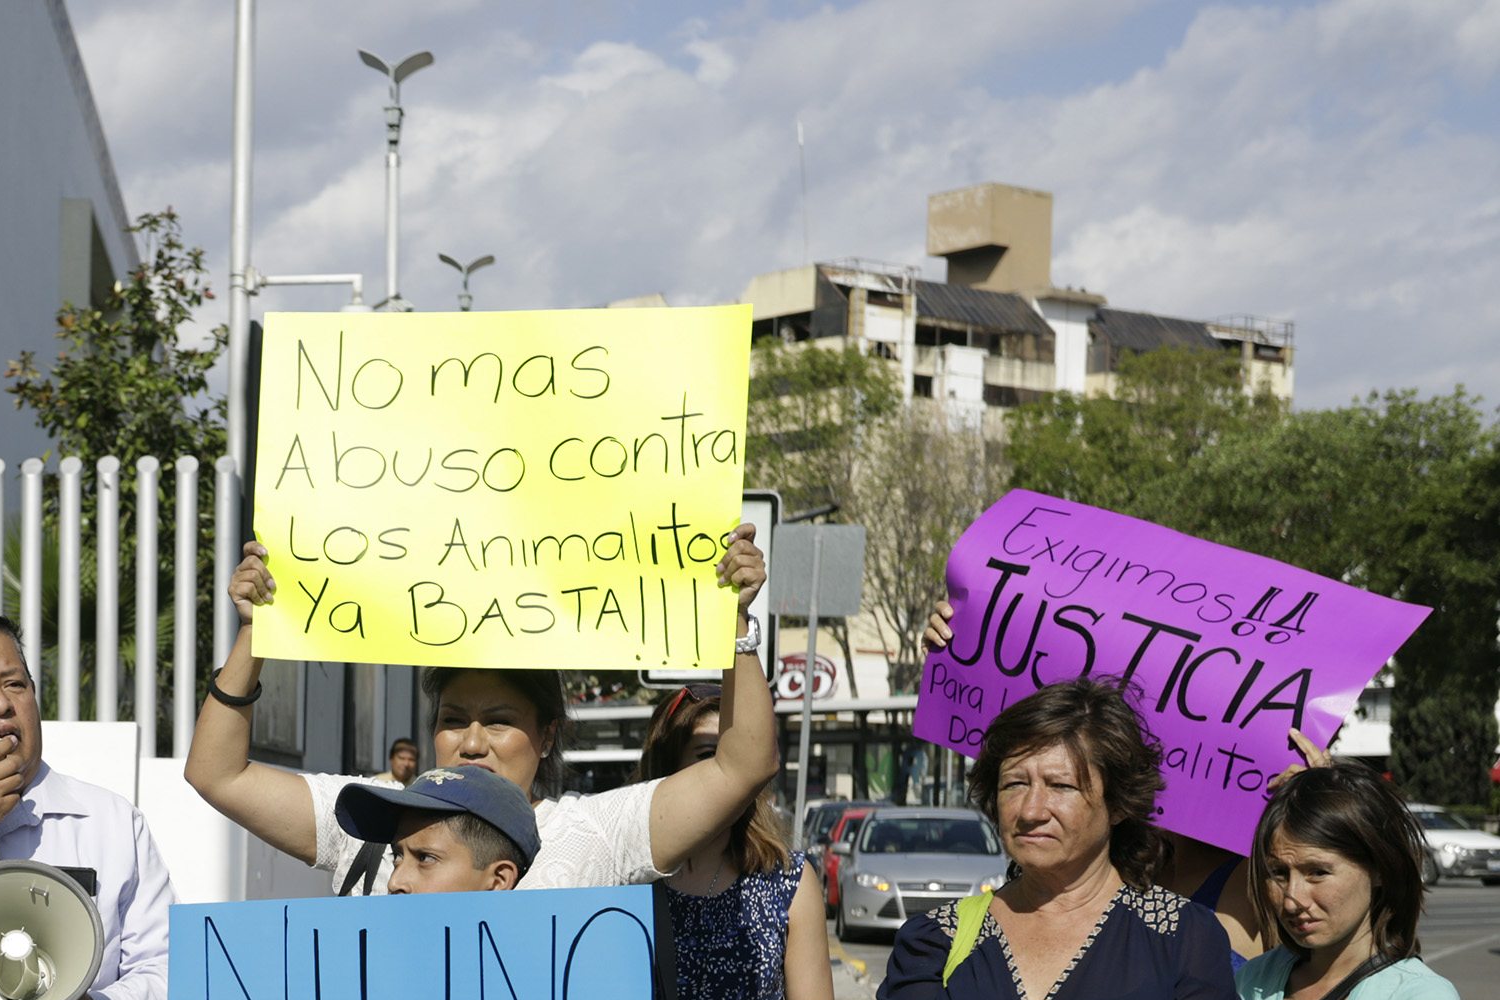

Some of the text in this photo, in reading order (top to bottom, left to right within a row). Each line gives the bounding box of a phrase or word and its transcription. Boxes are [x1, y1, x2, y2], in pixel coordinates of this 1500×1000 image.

[297, 331, 611, 411] No mas
[275, 390, 738, 493] Abuso contra
[297, 575, 701, 668] Ya BASTA!!!
[946, 556, 1313, 751] JUSTICIA
